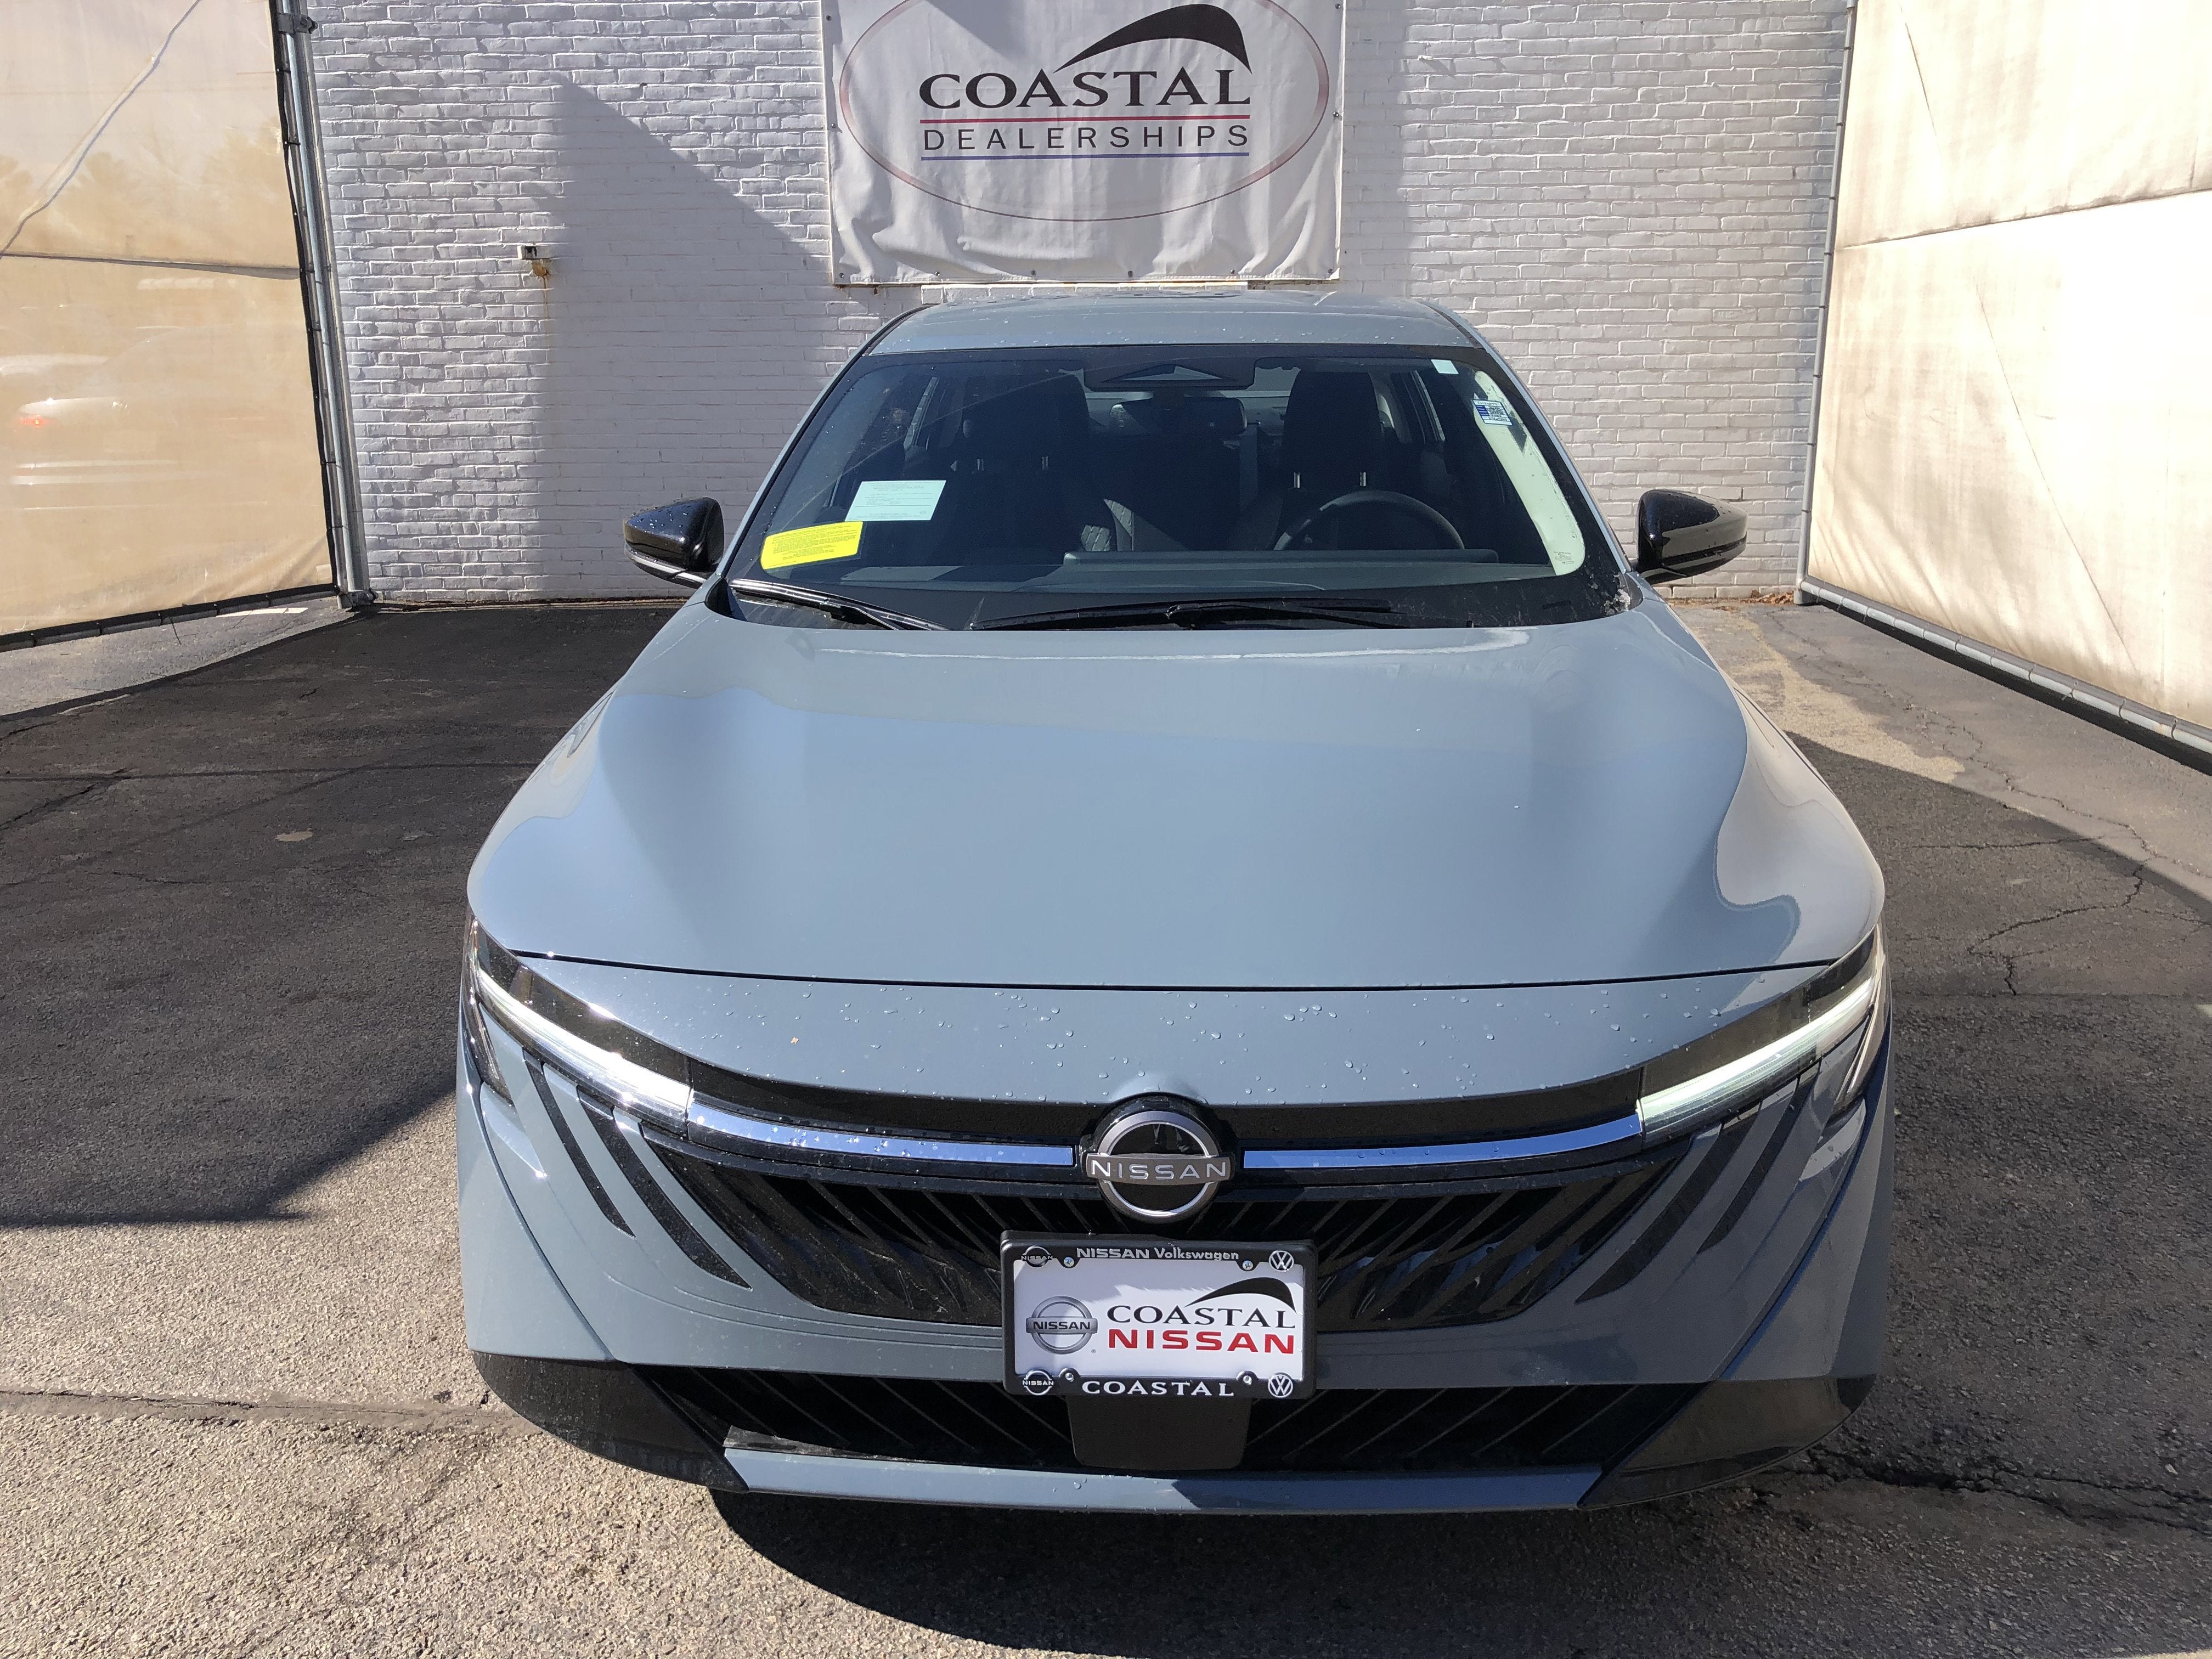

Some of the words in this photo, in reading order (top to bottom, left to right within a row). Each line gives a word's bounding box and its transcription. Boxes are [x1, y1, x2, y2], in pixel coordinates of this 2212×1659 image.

[919, 66, 1250, 109] COASTAL
[924, 125, 1248, 150] DEALERSHIPS
[1091, 1160, 1226, 1180] NISSAN
[1076, 1248, 1150, 1259] NISSAN
[1154, 1247, 1239, 1261] Volkswagen
[1033, 1321, 1091, 1330] NISSAN
[1107, 1305, 1296, 1328] COASTAL
[1109, 1329, 1294, 1354] NISSAN
[1082, 1380, 1234, 1397] COASTAL
